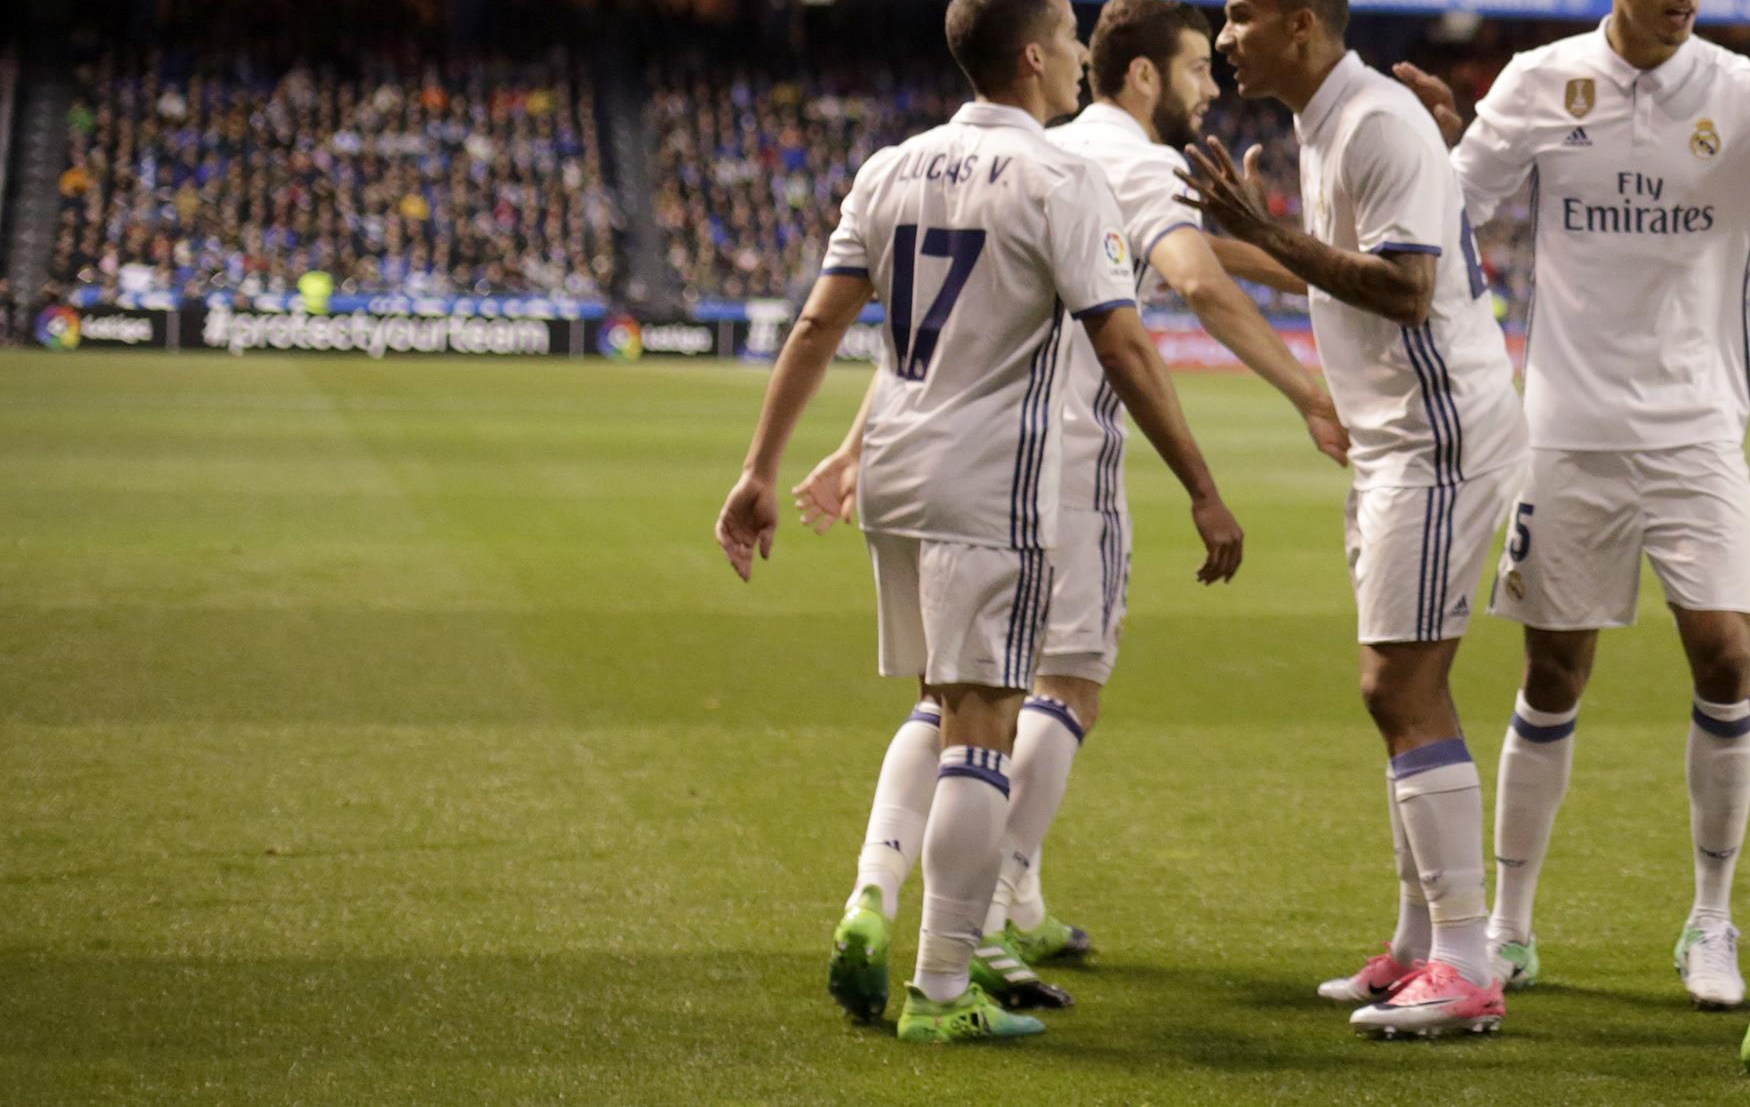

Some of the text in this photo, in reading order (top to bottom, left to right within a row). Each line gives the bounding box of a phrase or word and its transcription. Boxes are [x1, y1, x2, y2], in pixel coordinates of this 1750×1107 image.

[899, 152, 978, 186] LUCAS
[1617, 172, 1663, 200] Fly
[1563, 198, 1714, 234] Emirates
[891, 224, 986, 381] 17
[1510, 503, 1535, 563] 5
